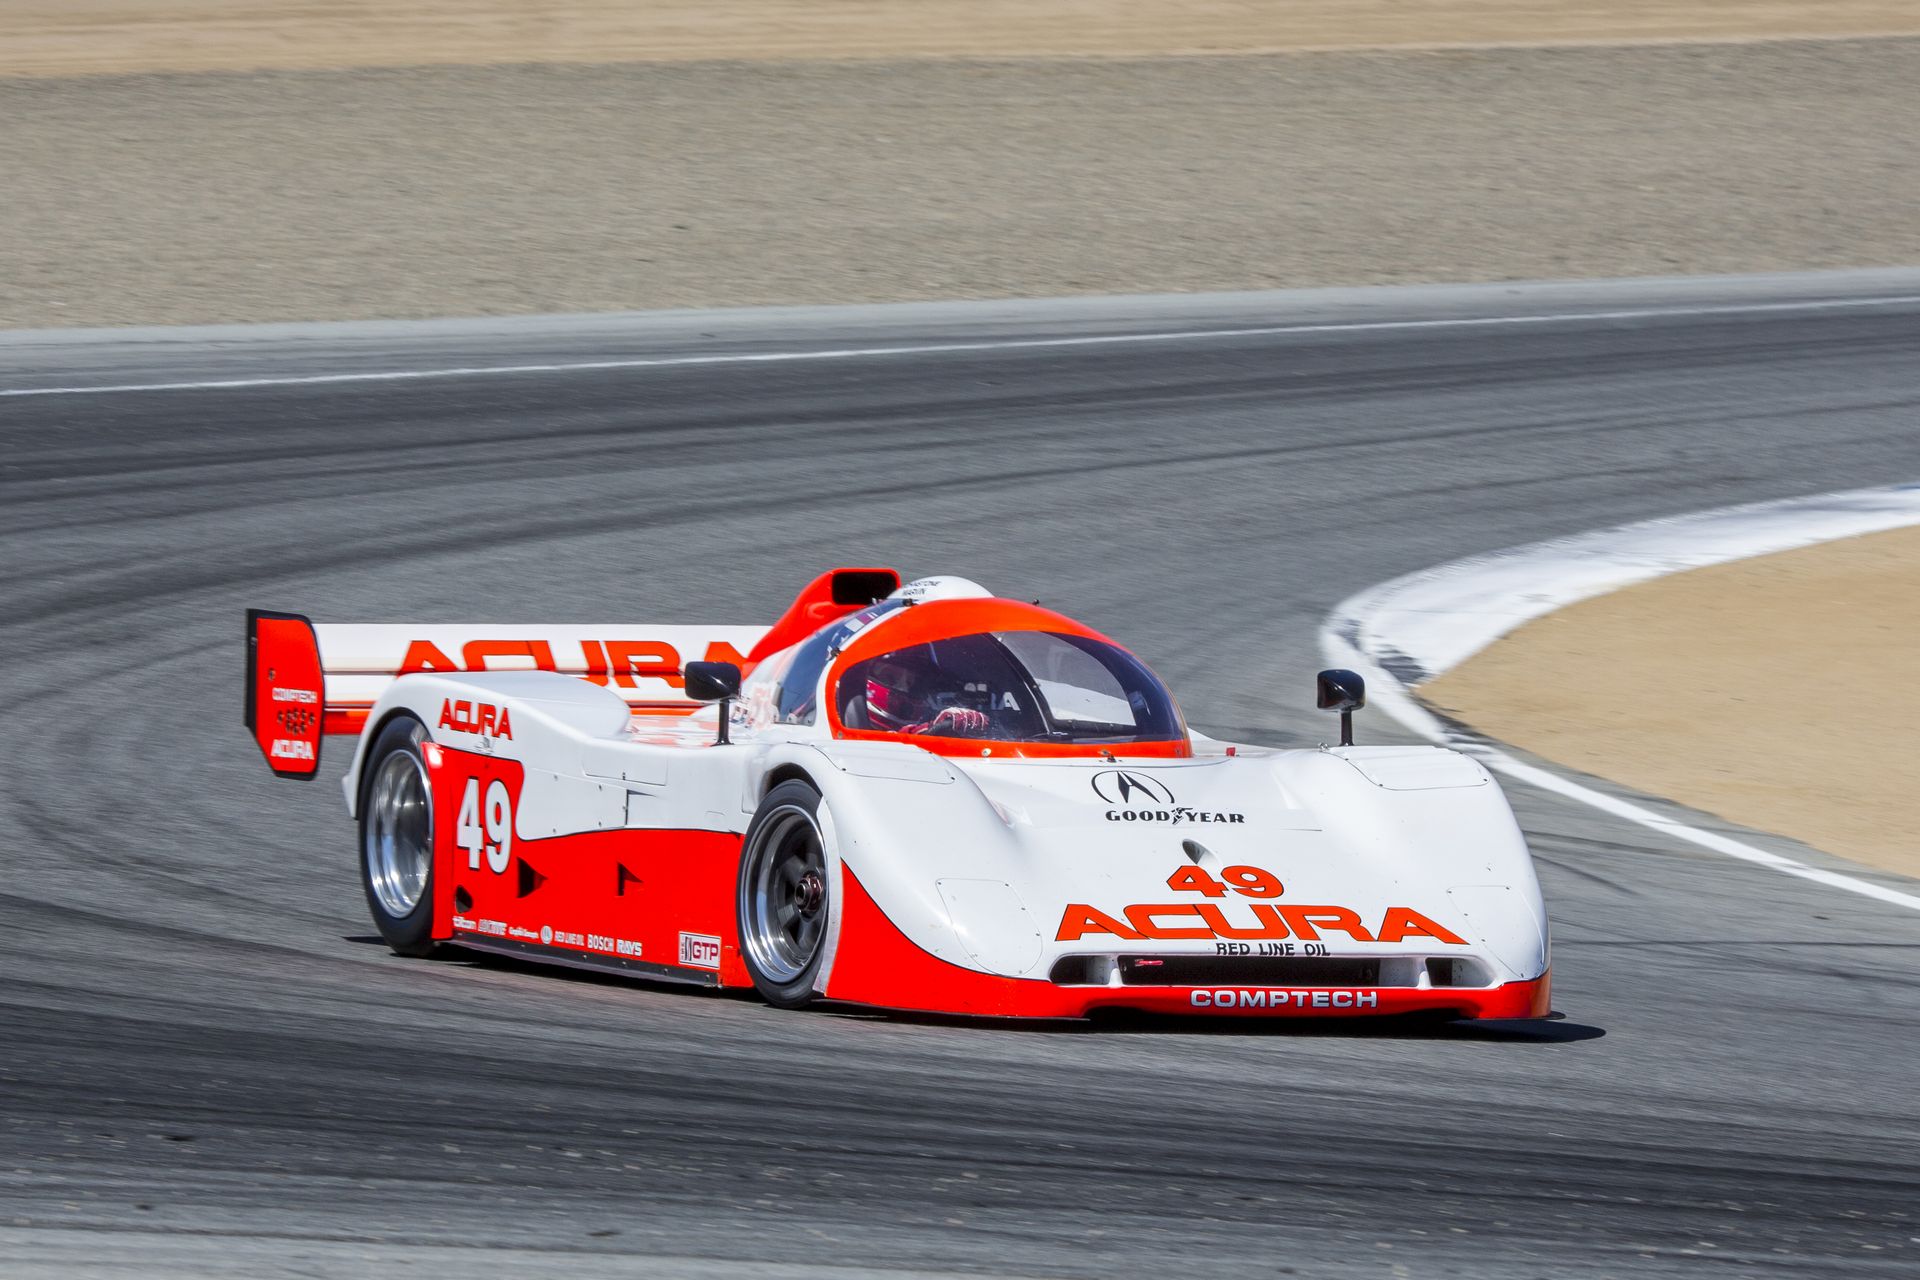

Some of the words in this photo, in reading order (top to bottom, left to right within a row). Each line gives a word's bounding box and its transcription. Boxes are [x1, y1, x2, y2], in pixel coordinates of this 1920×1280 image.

[438, 698, 513, 740] ACURA
[271, 739, 315, 760] ACURA
[456, 776, 512, 875] 49
[1166, 865, 1285, 899] 49
[1054, 903, 1471, 945] ACURA
[587, 933, 615, 952] BOSCH
[616, 939, 643, 957] RAYS
[692, 941, 719, 960] GTP
[1216, 943, 1251, 956] RED
[1259, 943, 1295, 956] LINE
[1304, 943, 1331, 957] OIL
[1190, 989, 1378, 1008] COMPTECH
